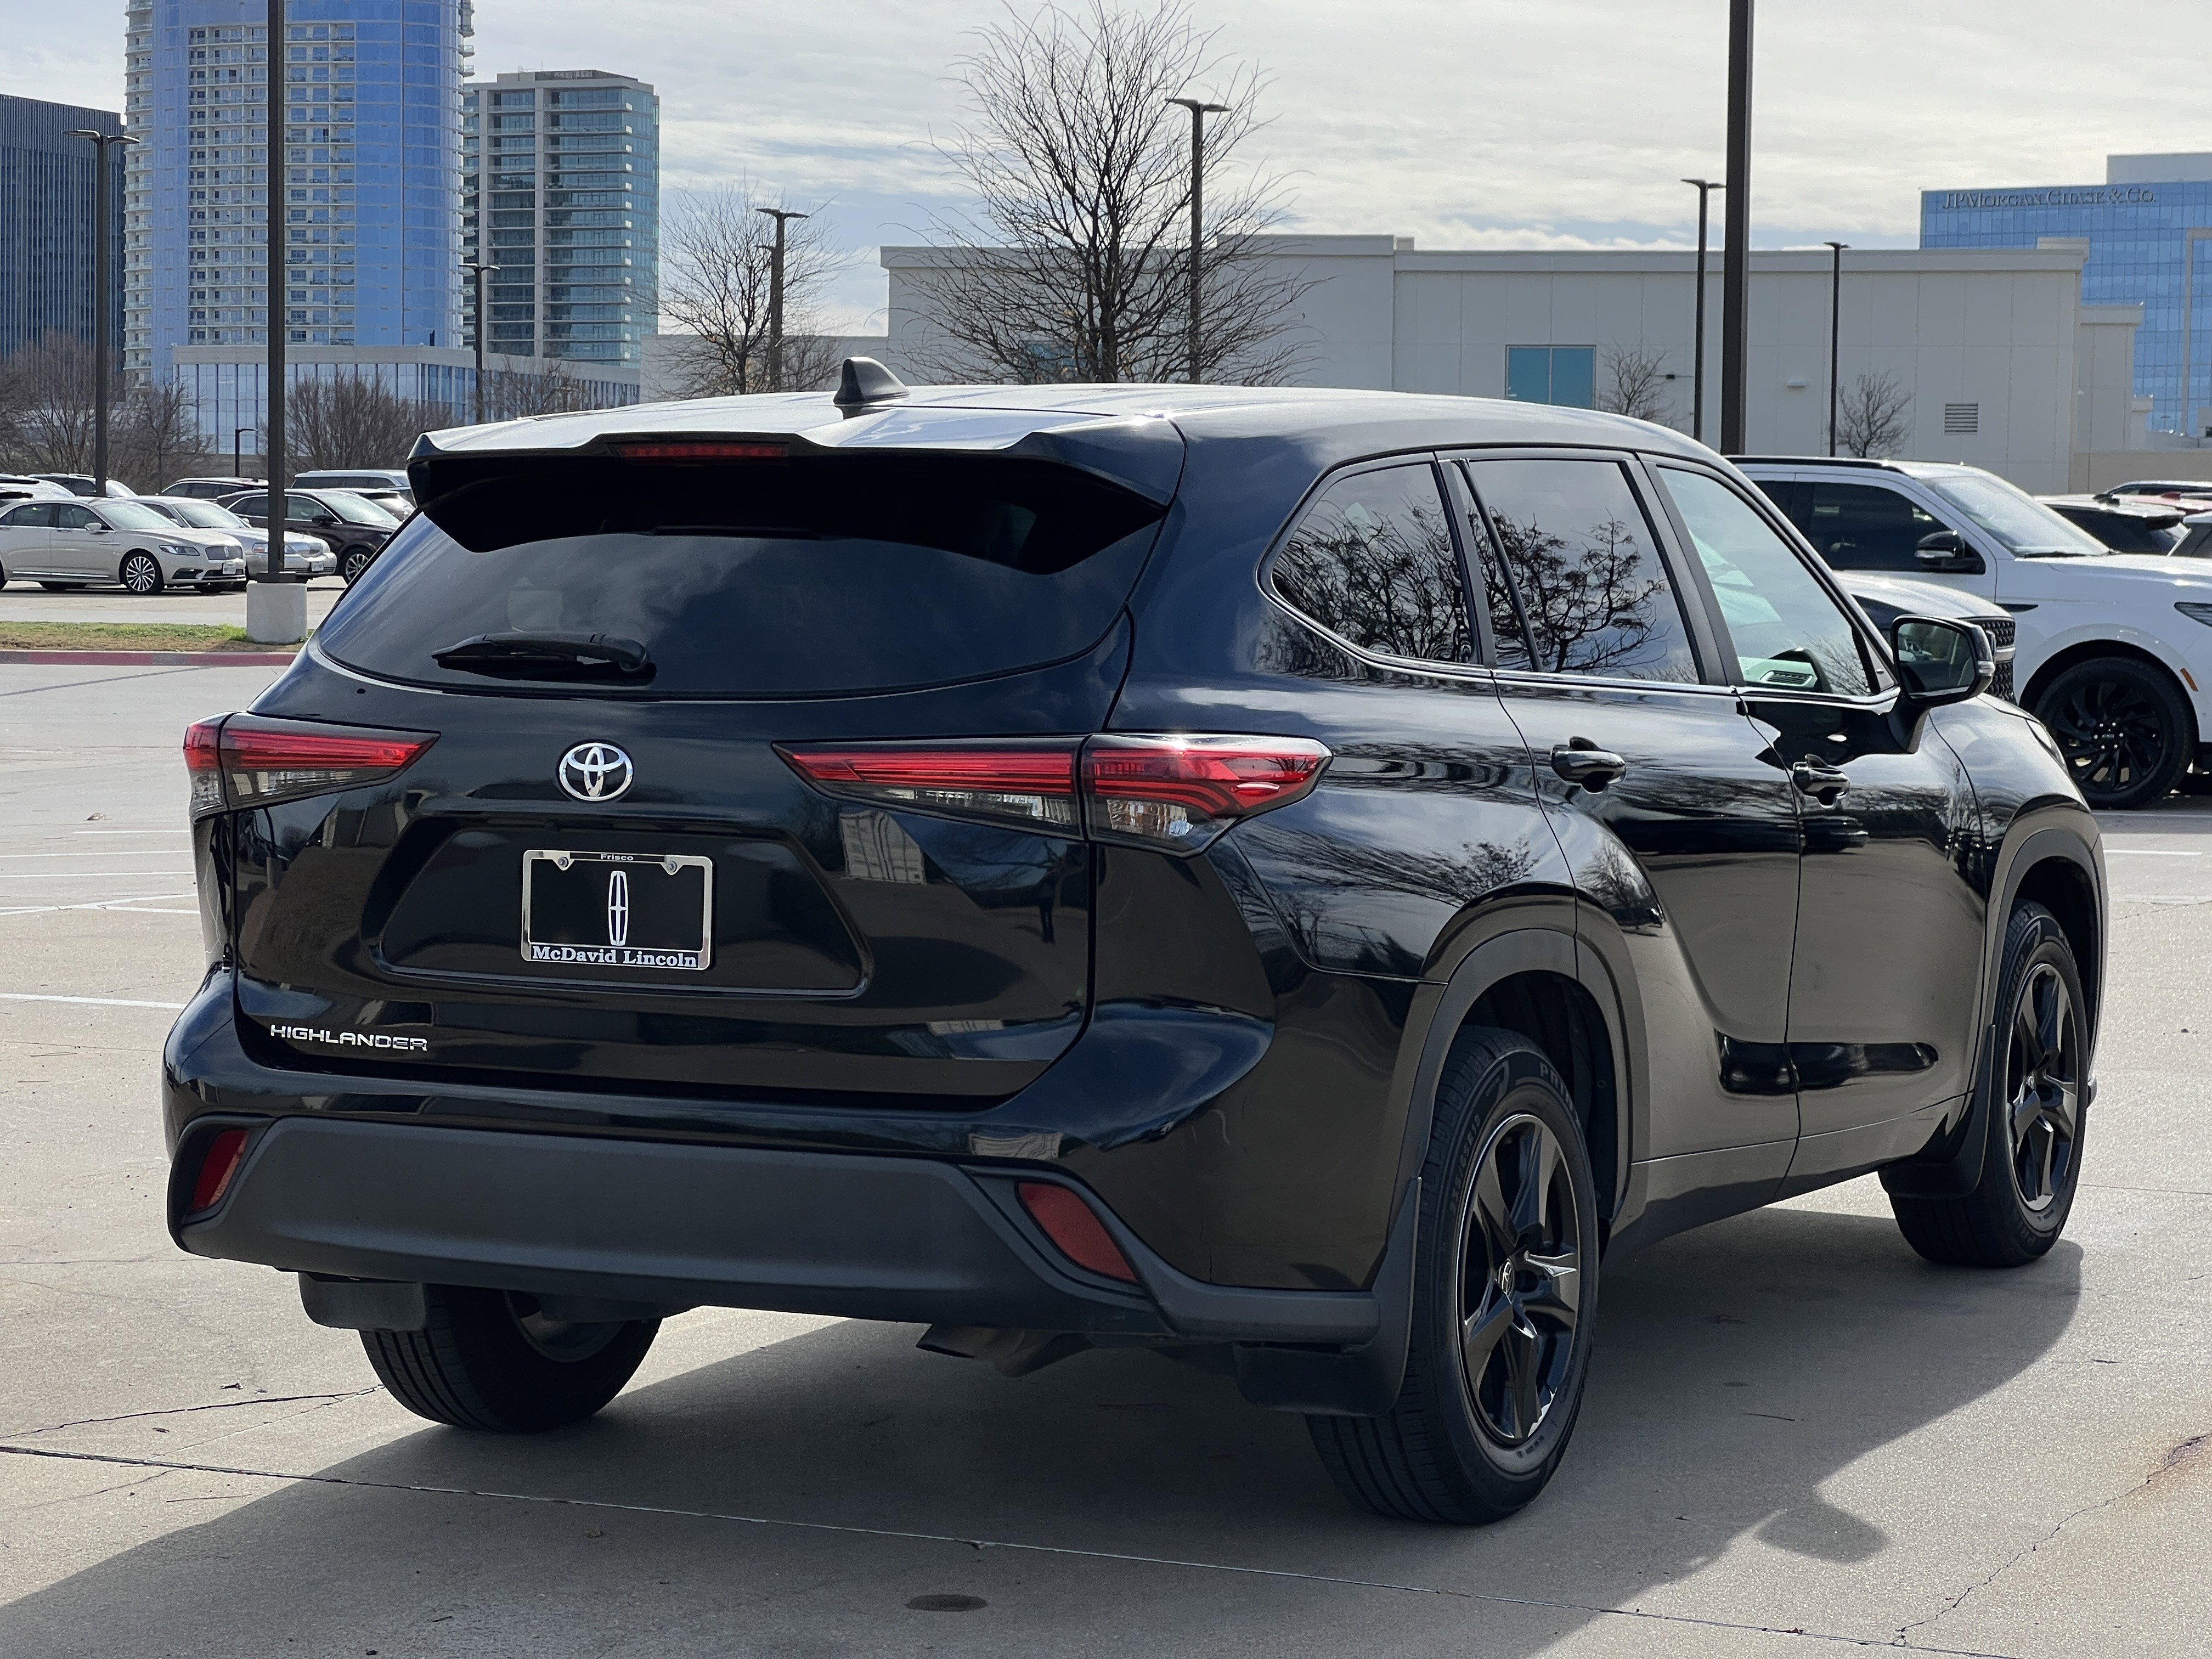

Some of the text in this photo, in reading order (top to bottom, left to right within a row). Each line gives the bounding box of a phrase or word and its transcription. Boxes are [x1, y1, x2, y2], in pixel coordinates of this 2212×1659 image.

[2108, 188, 2123, 204] &
[600, 853, 634, 861] Frisco
[532, 945, 697, 968] McDavid Lincoln
[270, 1024, 428, 1051] HIGHLANDER
